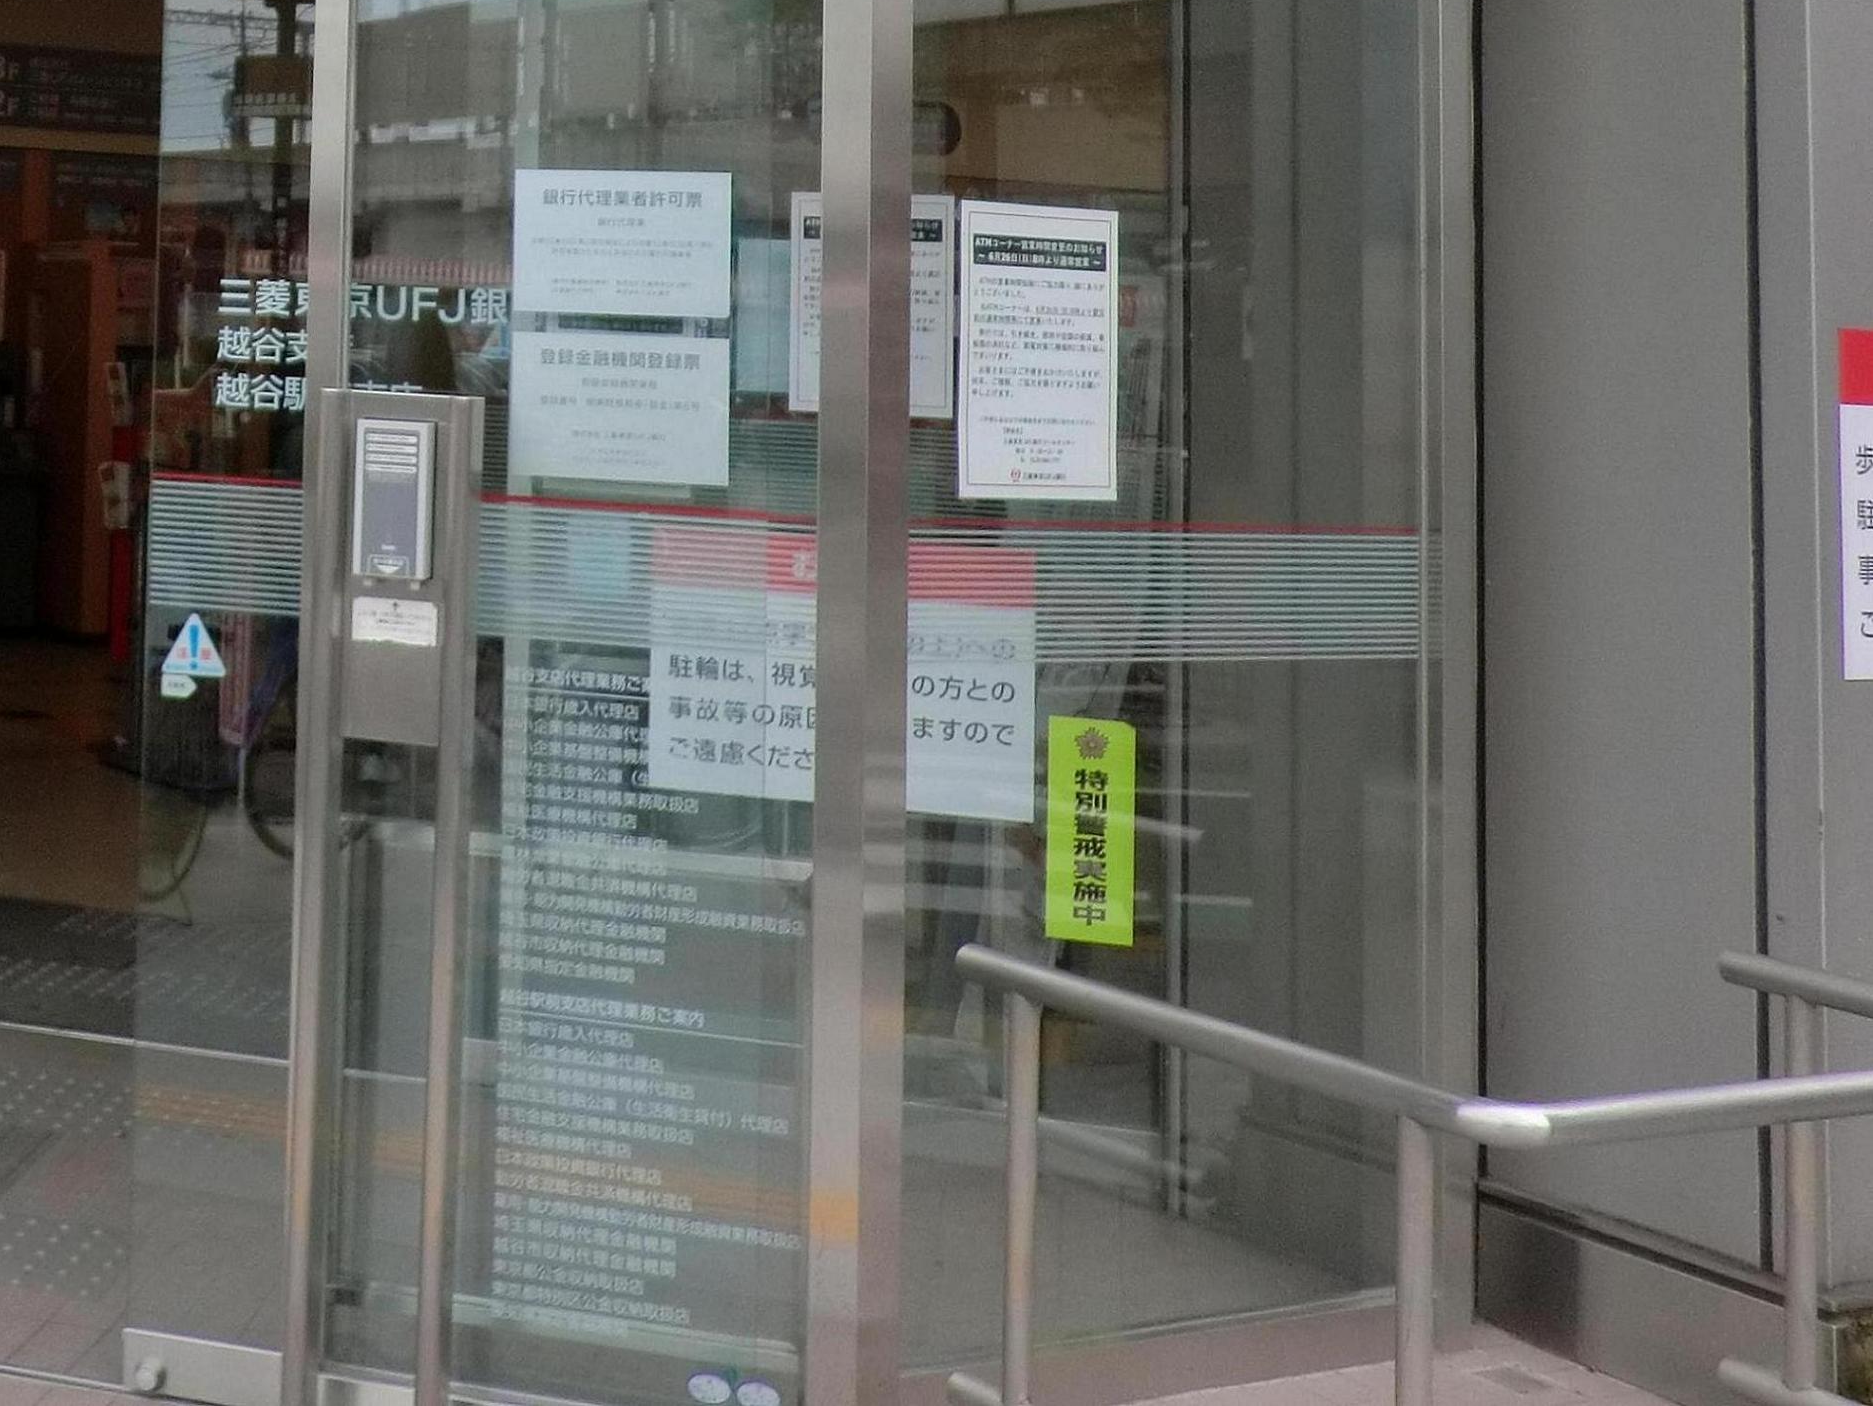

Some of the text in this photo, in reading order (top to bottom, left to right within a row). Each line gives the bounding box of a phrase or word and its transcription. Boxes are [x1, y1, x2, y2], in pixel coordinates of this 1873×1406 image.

[911, 675, 1015, 703] の方との
[912, 716, 1015, 747] ますので
[1073, 768, 1108, 927] 特別警戒実施中
